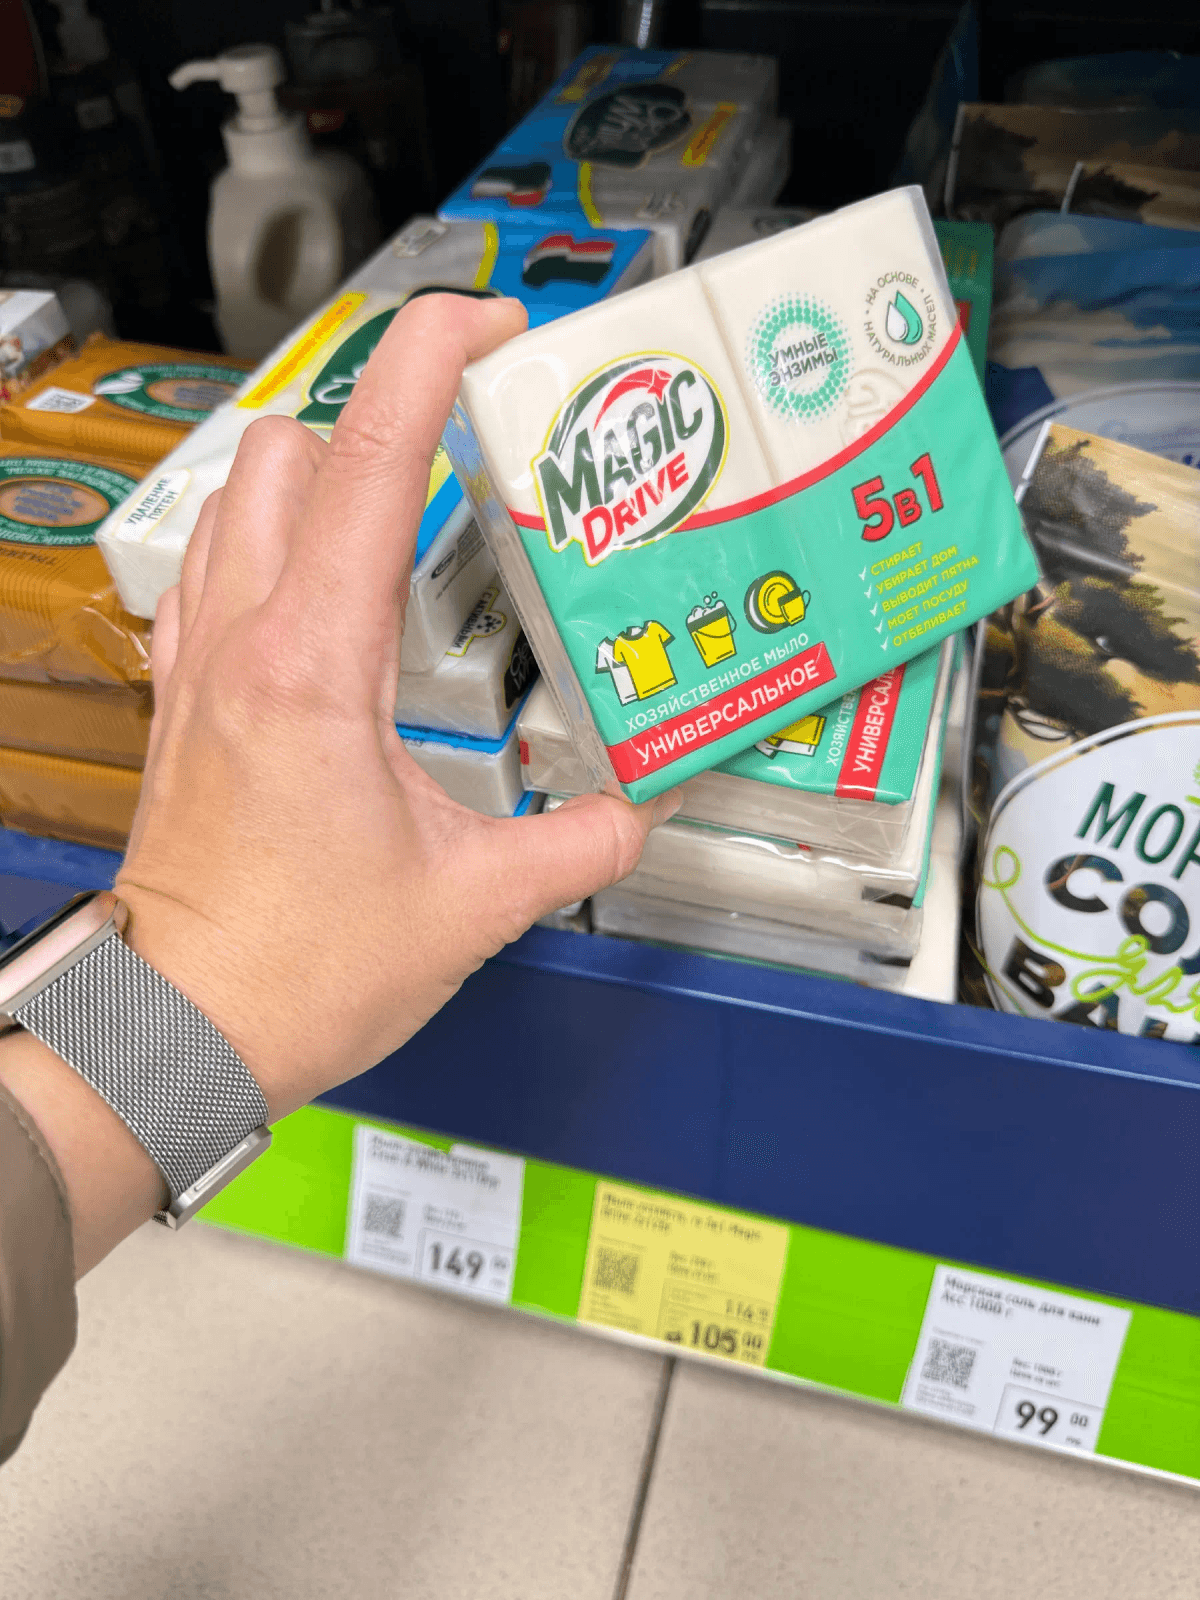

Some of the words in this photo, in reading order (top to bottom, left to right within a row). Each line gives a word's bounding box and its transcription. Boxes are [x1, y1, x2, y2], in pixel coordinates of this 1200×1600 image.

[865, 285, 880, 306] НА
[877, 270, 920, 289] ОСНОВЕ
[768, 332, 829, 368] УМНЫЕ
[863, 321, 933, 367] НАТУРАЛЬНЫХ
[923, 294, 937, 342] МАСЕЛ
[768, 346, 839, 387] ЭНЗИМЫ
[538, 369, 703, 546] MAGIC
[124, 478, 171, 525] УДАЛЕНИЕ
[147, 490, 180, 520] ПЯТЕН
[582, 451, 690, 560] DRIVE
[870, 541, 923, 577] СТИРАЕТ
[875, 559, 928, 596] УБИРАЕТ
[931, 545, 958, 570] ДОМ
[881, 574, 939, 613] ВЫВОДИТ
[940, 555, 980, 583] ПЯТНА
[887, 604, 920, 631] МОЕТ
[922, 578, 970, 613] ПОСУДУ
[892, 600, 968, 647] ОТБЕЛИВАЕТ
[625, 657, 762, 733] ХОЗЯЙСТВЕННОЕ
[763, 632, 809, 665] МЫЛО
[636, 659, 820, 766] УНИВЕРСАЛЬНОЕ
[1042, 853, 1200, 976] СО
[430, 1241, 485, 1281] 149
[943, 1275, 1002, 1301] Морская
[691, 1319, 738, 1354] 105
[1015, 1400, 1059, 1436] 99
